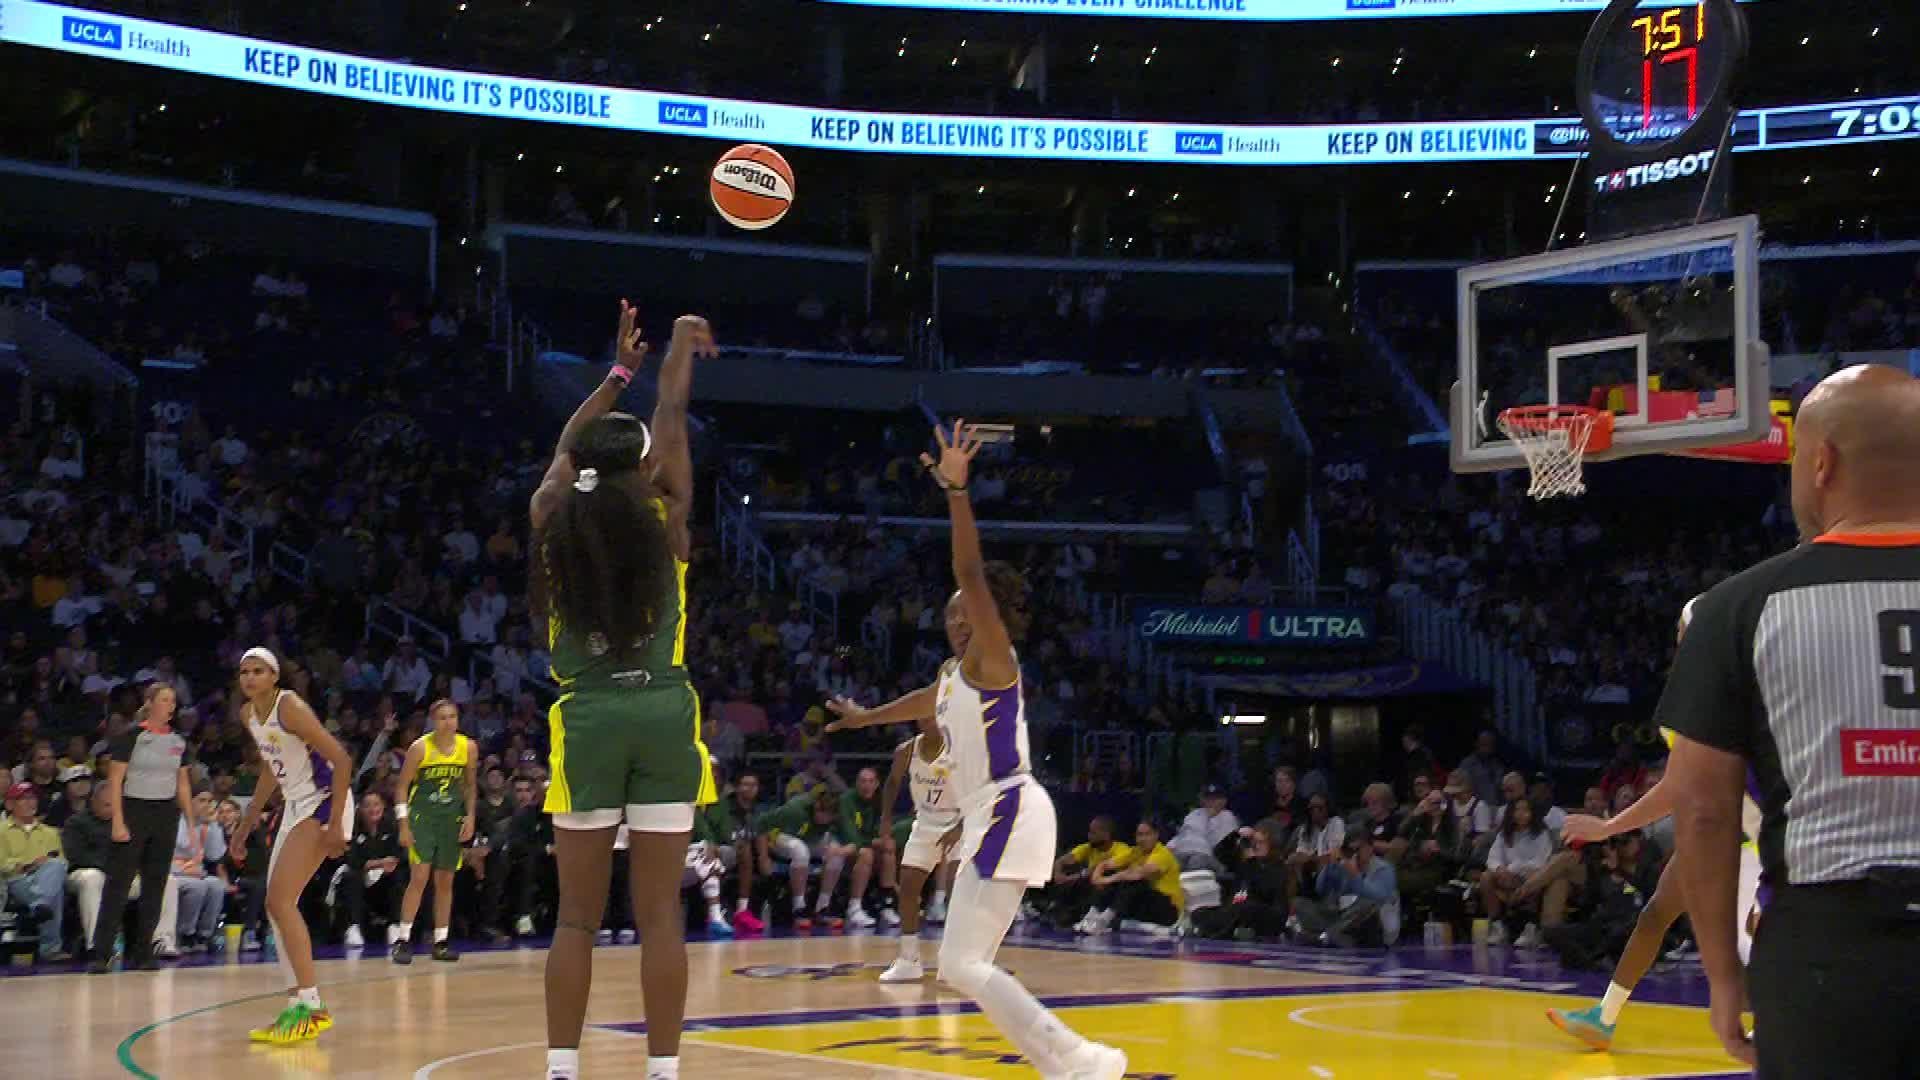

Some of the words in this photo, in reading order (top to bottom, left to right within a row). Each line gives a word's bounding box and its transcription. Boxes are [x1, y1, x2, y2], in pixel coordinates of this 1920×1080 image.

[70, 22, 115, 43] UCLA
[128, 31, 191, 57] Health
[1631, 3, 1704, 55] 7:51
[244, 47, 300, 78] KEEP
[308, 57, 337, 86] ON
[345, 63, 455, 103] BELIEVING
[463, 79, 502, 107] IT'S
[510, 86, 611, 118] POSSIBLE
[1642, 47, 1697, 129] 17
[664, 105, 702, 122] UCLA
[713, 110, 766, 129] Health
[1830, 105, 1920, 137] 7:0
[811, 116, 860, 142] KEEP
[867, 119, 894, 144] ON
[901, 121, 1003, 148] BELIEVING
[1010, 126, 1046, 149] IT'S
[1053, 127, 1149, 153] POSSIBLE
[1181, 135, 1217, 151] UCLA
[1228, 136, 1280, 152] Health
[1327, 131, 1378, 155] KEEP
[1385, 130, 1413, 153] ON
[1420, 127, 1526, 153] BELIEVING
[723, 163, 777, 191] Wilson
[1625, 150, 1718, 188] TISSOT
[1141, 609, 1241, 638] Michelob
[1269, 615, 1367, 638] ULTRA
[1854, 739, 1920, 765] Emir
[926, 789, 943, 805] 17
